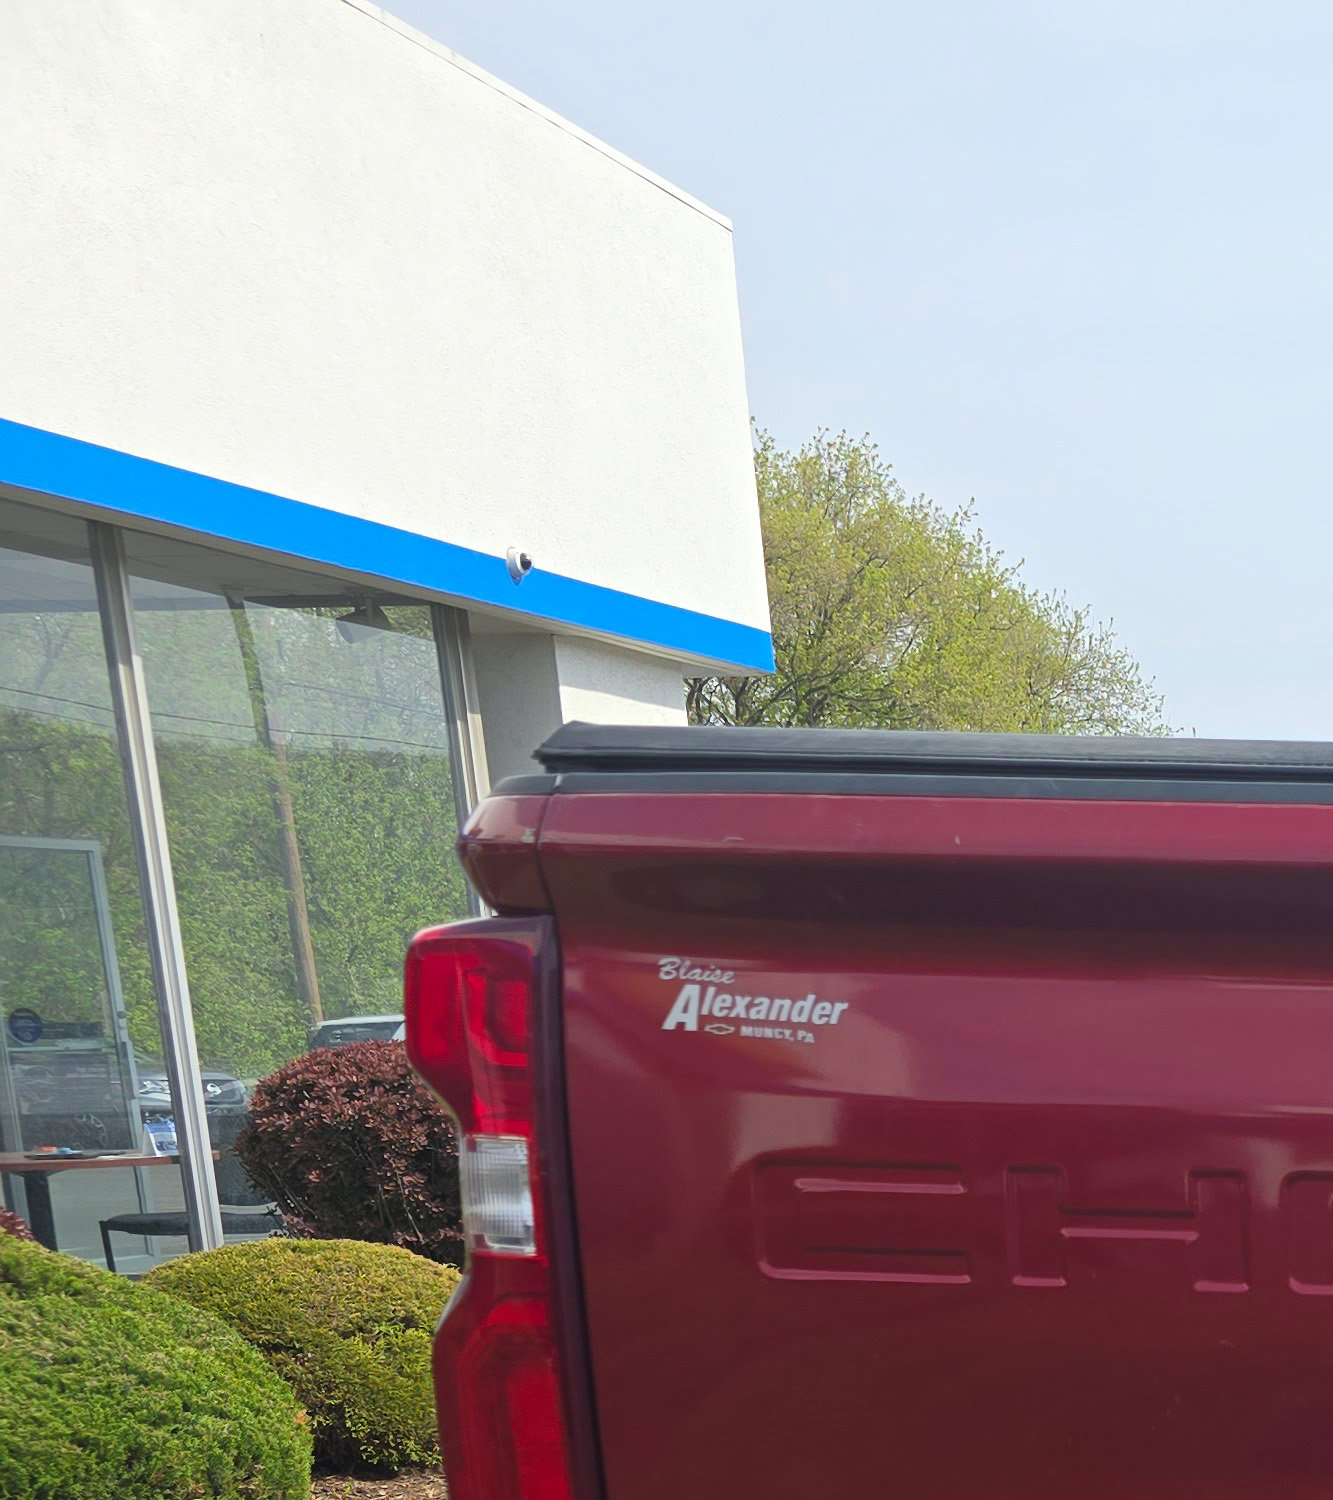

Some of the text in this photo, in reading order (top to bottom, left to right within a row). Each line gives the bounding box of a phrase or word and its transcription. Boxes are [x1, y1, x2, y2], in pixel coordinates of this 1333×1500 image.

[658, 956, 735, 984] Blaise
[662, 984, 849, 1031] Alexander
[740, 1025, 815, 1043] MUNCY, PA
